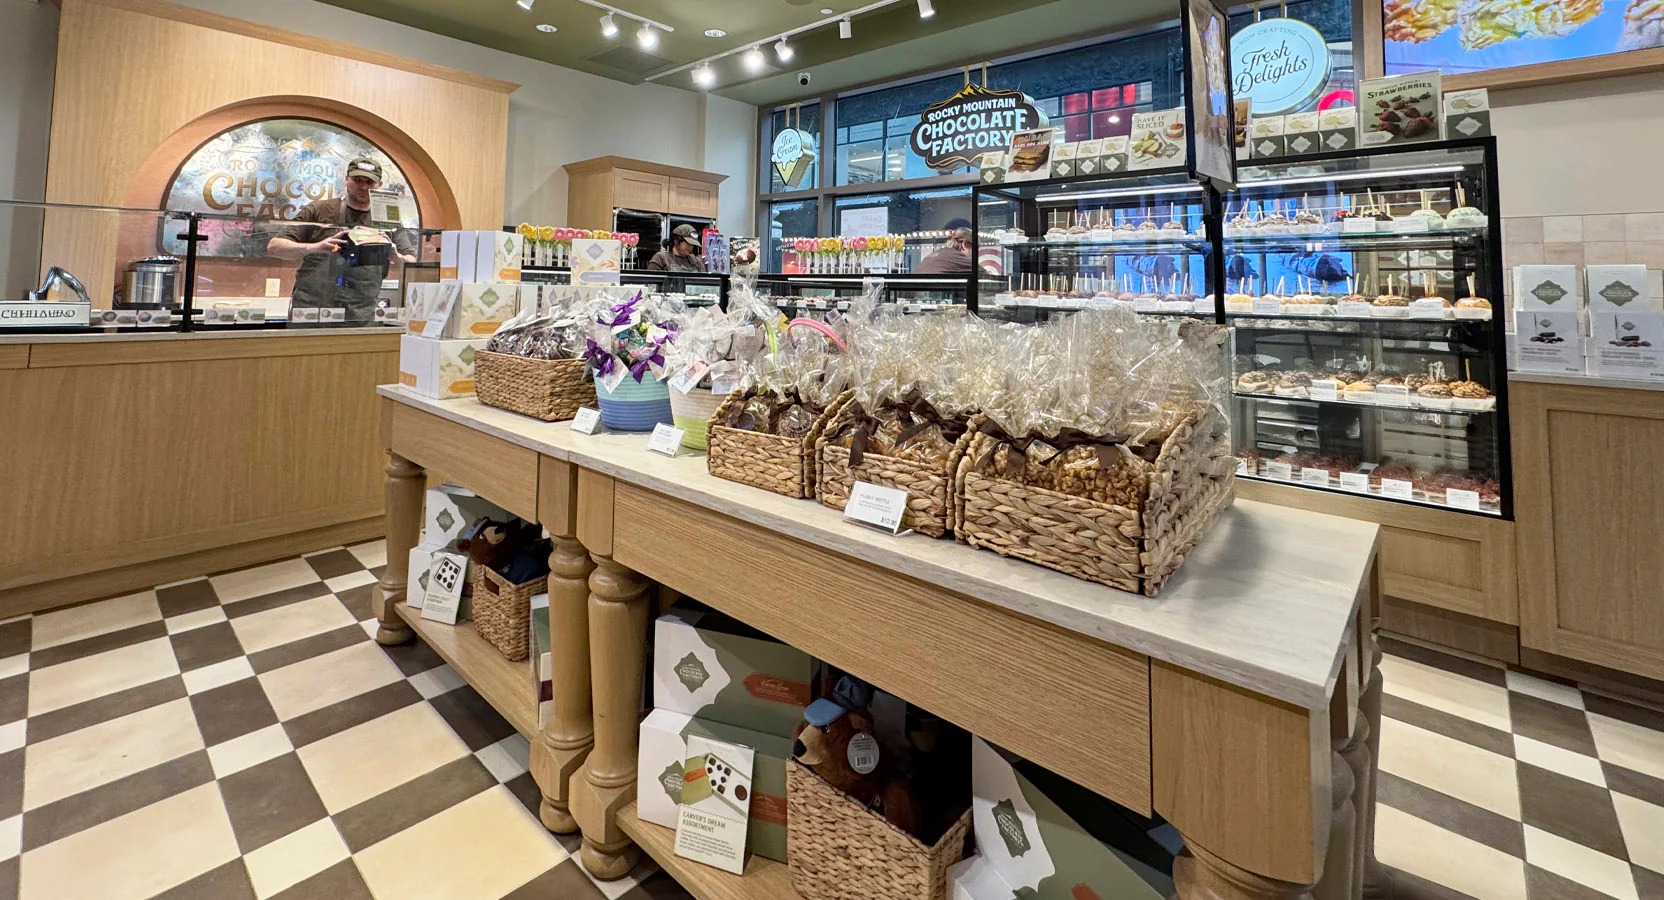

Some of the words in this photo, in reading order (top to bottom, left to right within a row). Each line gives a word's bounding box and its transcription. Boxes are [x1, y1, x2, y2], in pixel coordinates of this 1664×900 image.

[1257, 27, 1297, 37] CRAFTING
[1242, 40, 1291, 72] Fresh
[1233, 55, 1308, 96] Delights
[1367, 82, 1432, 99] STRAWBERRIES
[927, 104, 960, 123] ROCKY
[963, 98, 1016, 113] MOUNTAIN
[916, 108, 1029, 151] CHOCOLATE
[1136, 121, 1165, 129] SLICED
[931, 129, 1015, 157] FACTORY
[298, 163, 346, 178] MOUN
[203, 172, 334, 211] CHOCOL
[682, 818, 715, 833] ASSORTMENT
[683, 811, 706, 824] CARVER'S
